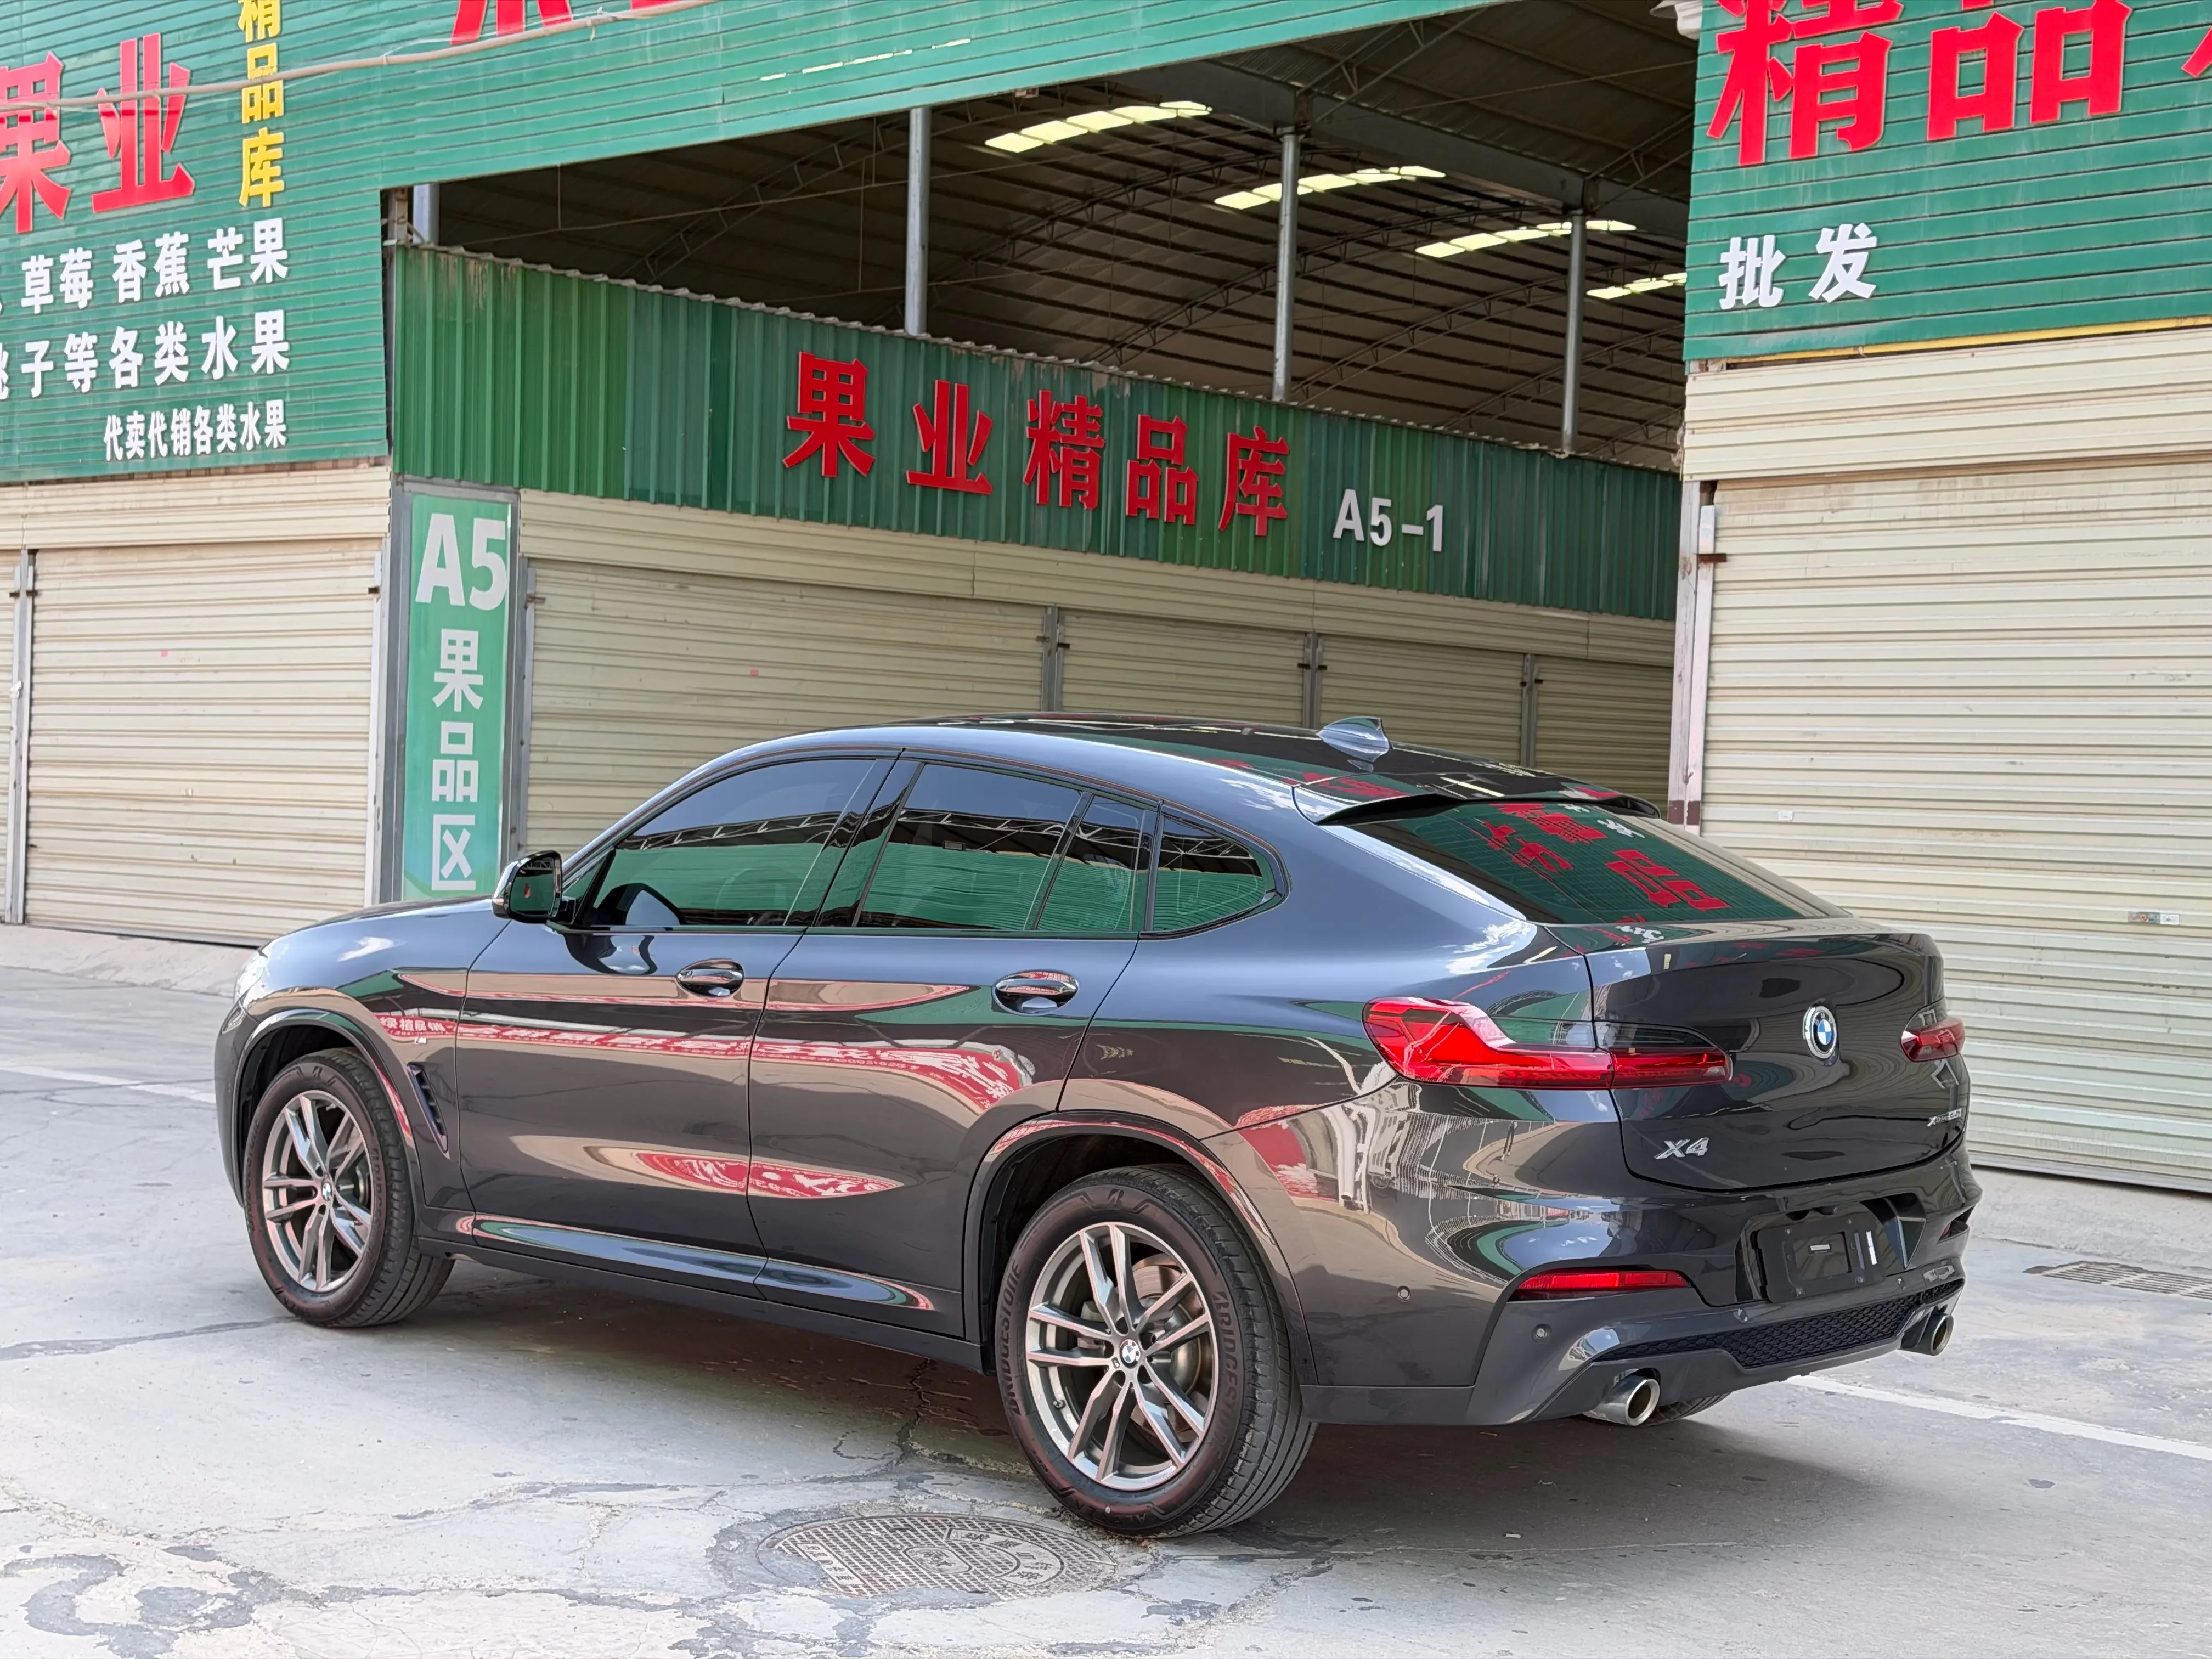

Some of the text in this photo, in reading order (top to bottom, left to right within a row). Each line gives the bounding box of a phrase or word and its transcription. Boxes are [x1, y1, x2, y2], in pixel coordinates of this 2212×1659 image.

[21, 218, 289, 313] 草莓 香蕉 芒果
[1718, 222, 1877, 309] 批发
[104, 399, 288, 462] 代卖代销各类水果
[783, 351, 1443, 552] 果业精品库 A5-1
[415, 513, 508, 611] A5
[432, 629, 484, 891] 果品区
[1654, 1137, 1709, 1159] X4
